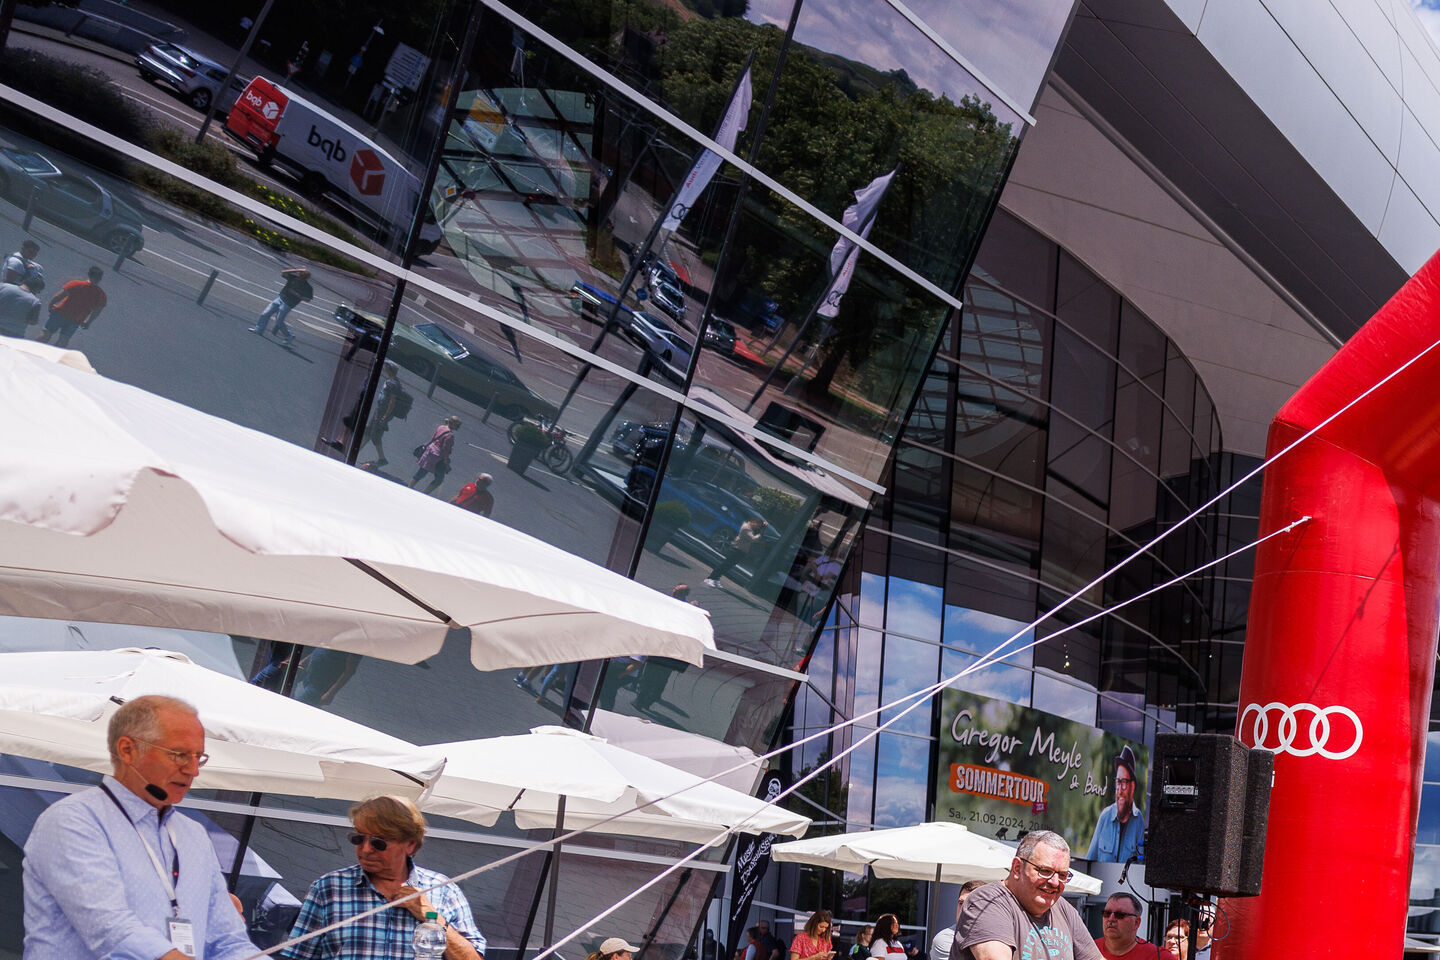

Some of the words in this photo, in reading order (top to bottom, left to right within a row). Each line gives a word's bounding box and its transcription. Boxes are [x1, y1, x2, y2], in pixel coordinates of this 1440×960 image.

[951, 708, 1024, 764] Gregor
[1028, 725, 1083, 782] Meyle
[956, 765, 1045, 803] SOMMERTOUR
[1083, 771, 1108, 797] Band
[969, 810, 1027, 830] 21.09.2024,
